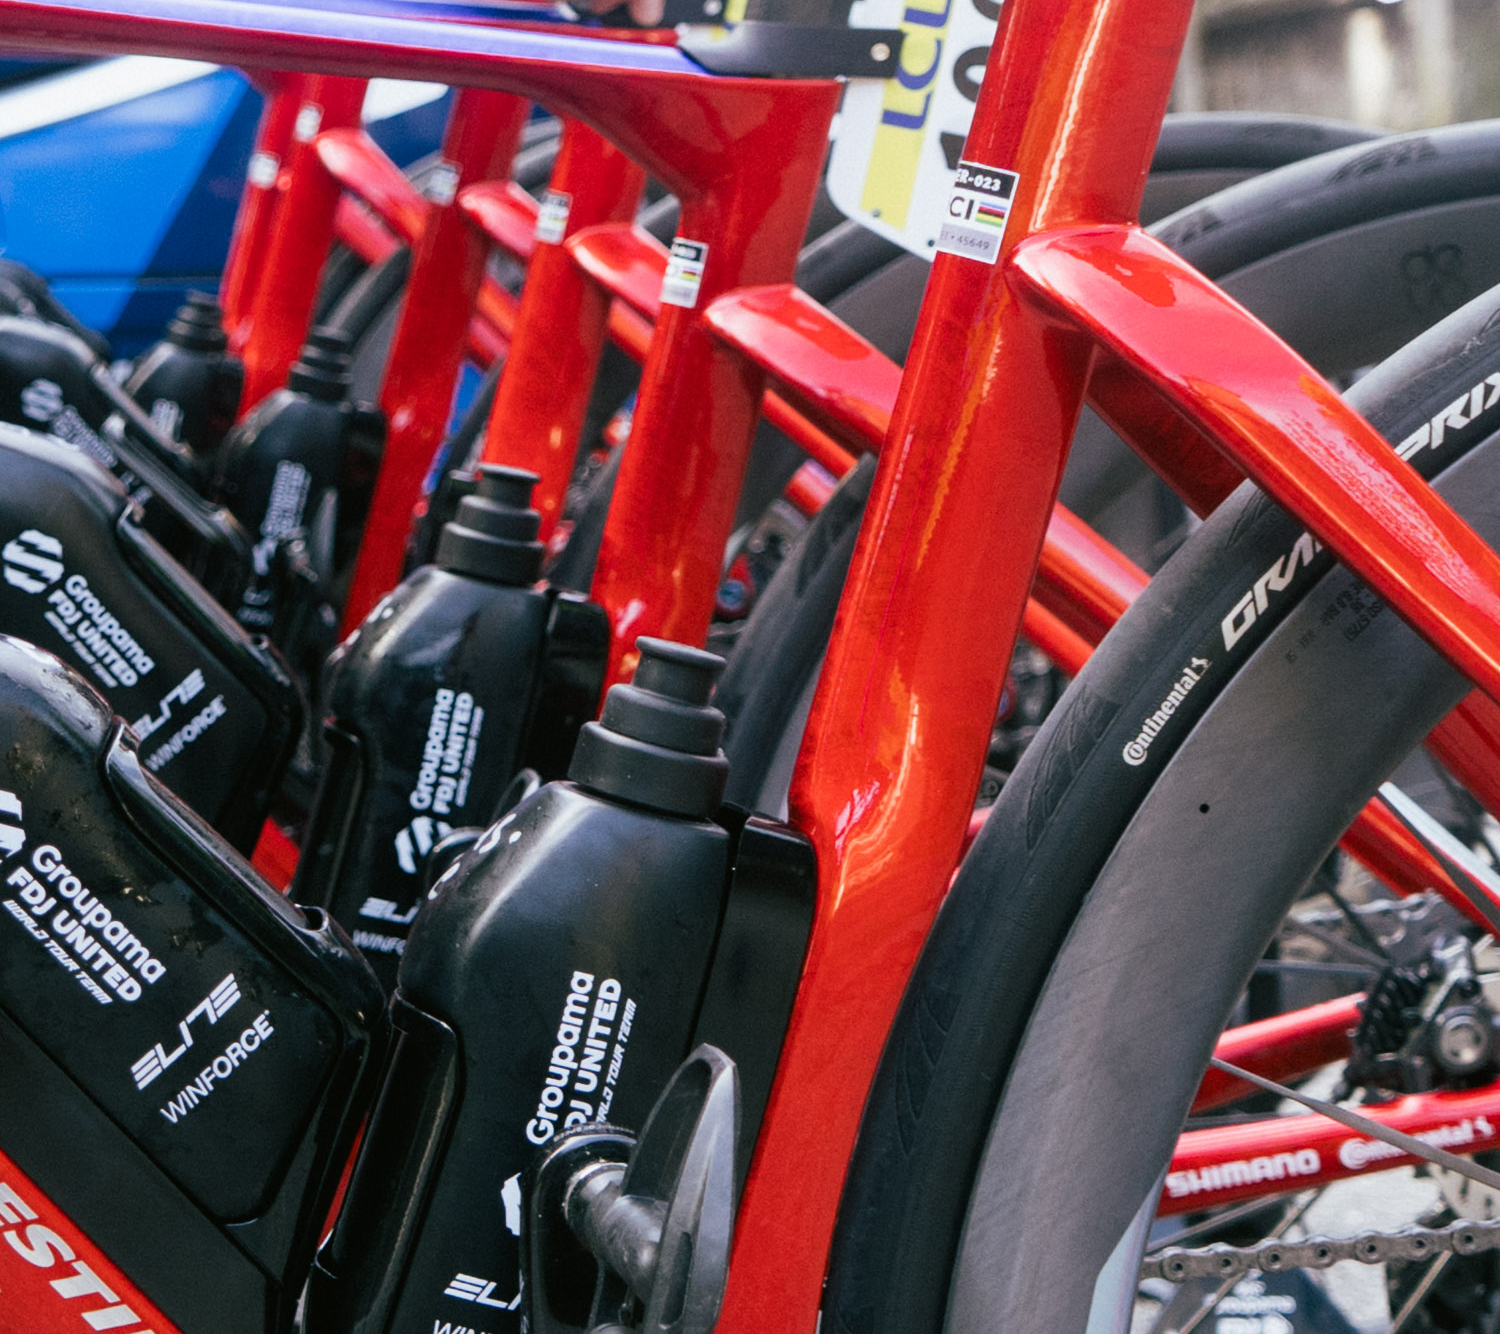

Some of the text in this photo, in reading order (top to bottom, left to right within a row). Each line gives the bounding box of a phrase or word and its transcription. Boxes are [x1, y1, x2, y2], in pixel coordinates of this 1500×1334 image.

[949, 195, 976, 221] CI
[46, 588, 139, 688] FDJ UNITED
[64, 573, 156, 676] Groupama
[1220, 531, 1325, 652] GRA
[409, 687, 456, 810] Groupama
[441, 692, 475, 774] UNITED
[1121, 667, 1202, 768] Continental
[2, 899, 114, 1005] WORLD TOUR TEAM
[6, 866, 142, 1002] FDJ UNITED
[31, 844, 168, 984] Groupama
[130, 972, 242, 1091] ELITE
[159, 1010, 275, 1124] WINFORCE
[525, 970, 596, 1146] Groupama
[574, 977, 623, 1095] UNITED
[595, 996, 638, 1124] RLD TOUR TEAM
[563, 1098, 594, 1130] DJ
[1165, 1148, 1322, 1199] SHIMANO
[443, 1273, 523, 1312] ELI
